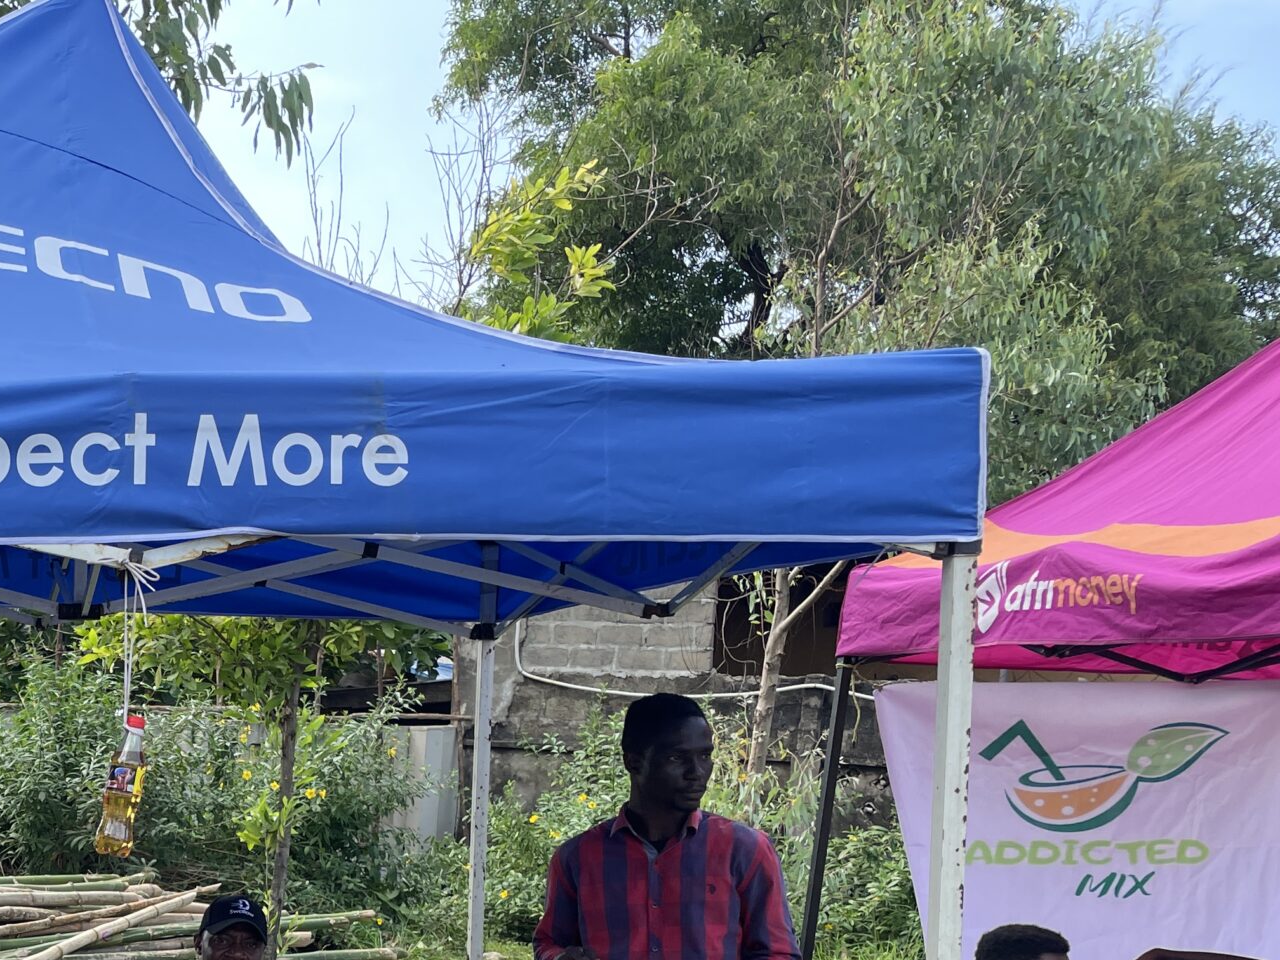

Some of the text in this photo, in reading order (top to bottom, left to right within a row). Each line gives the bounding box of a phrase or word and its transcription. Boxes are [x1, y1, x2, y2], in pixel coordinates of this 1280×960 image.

[187, 413, 409, 488] More
[1004, 569, 1144, 615] afrimoney
[964, 838, 1210, 867] ADDICTED
[1075, 871, 1156, 898] MIX
